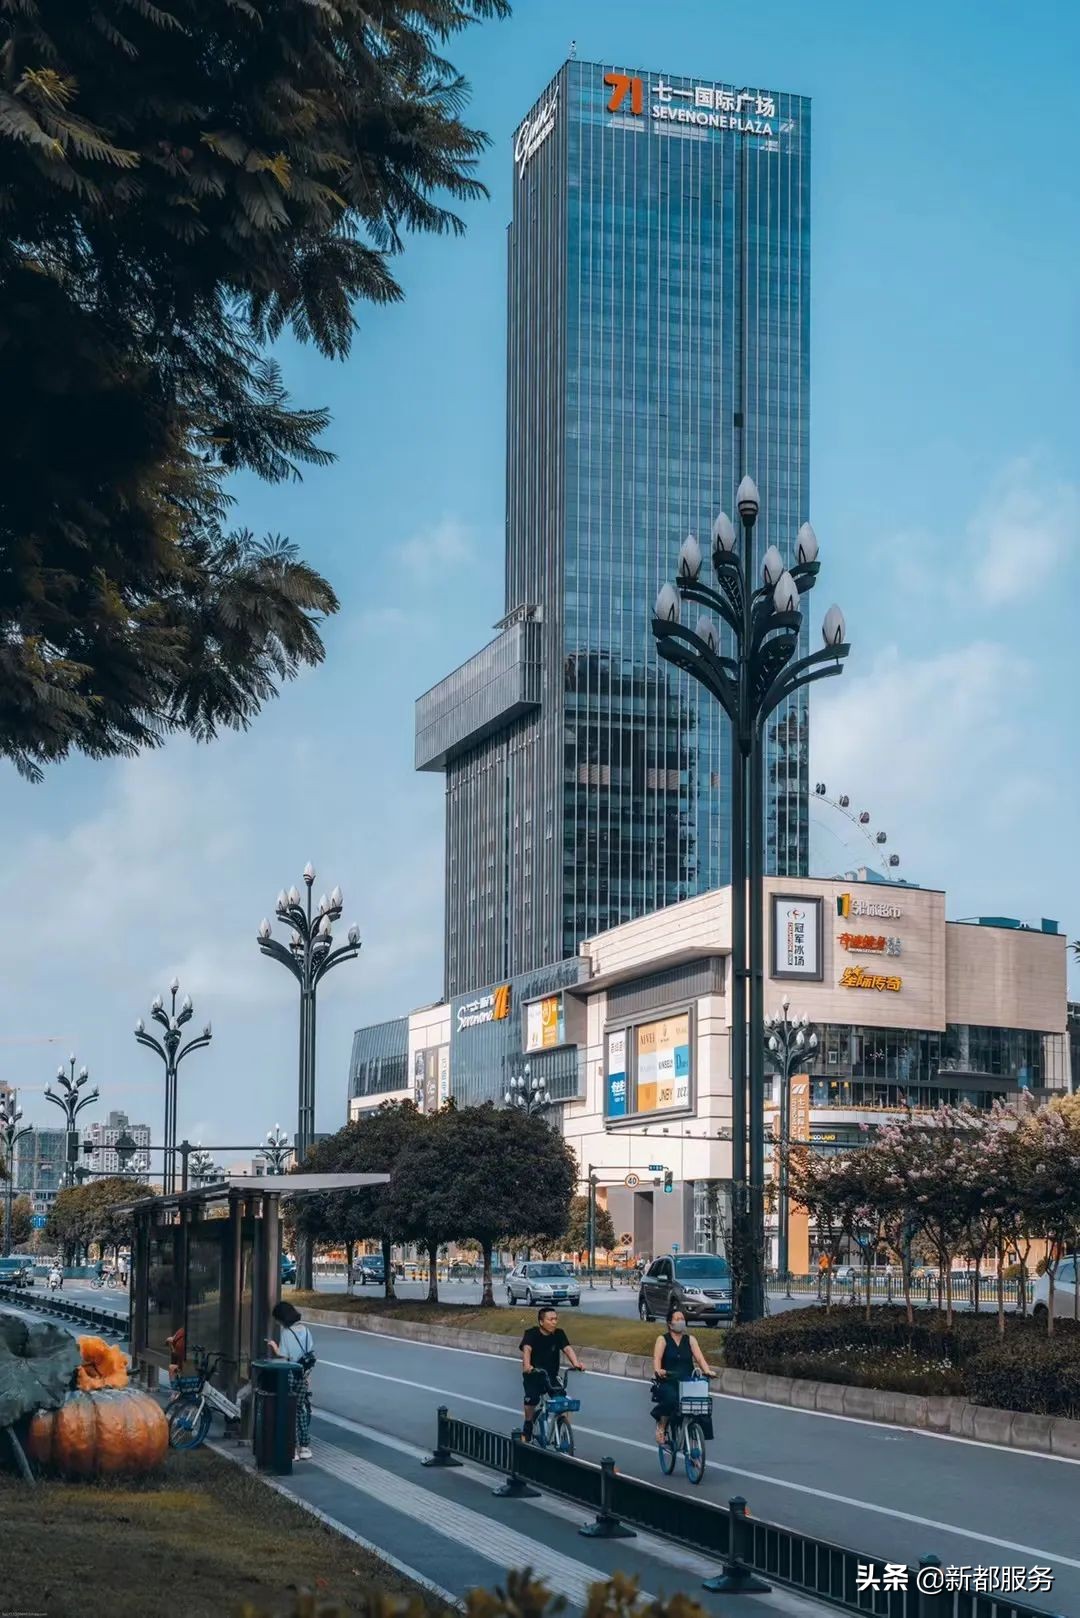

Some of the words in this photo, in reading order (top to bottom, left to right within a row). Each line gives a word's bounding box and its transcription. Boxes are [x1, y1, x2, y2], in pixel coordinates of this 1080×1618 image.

[604, 73, 643, 115] 71
[652, 80, 775, 117] 七一国际广场
[652, 104, 729, 128] SEVENONE
[729, 117, 773, 136] PLAZA
[795, 922, 804, 966] 冠军冰场
[839, 965, 903, 992] 星际传奇
[628, 1176, 637, 1185] 40
